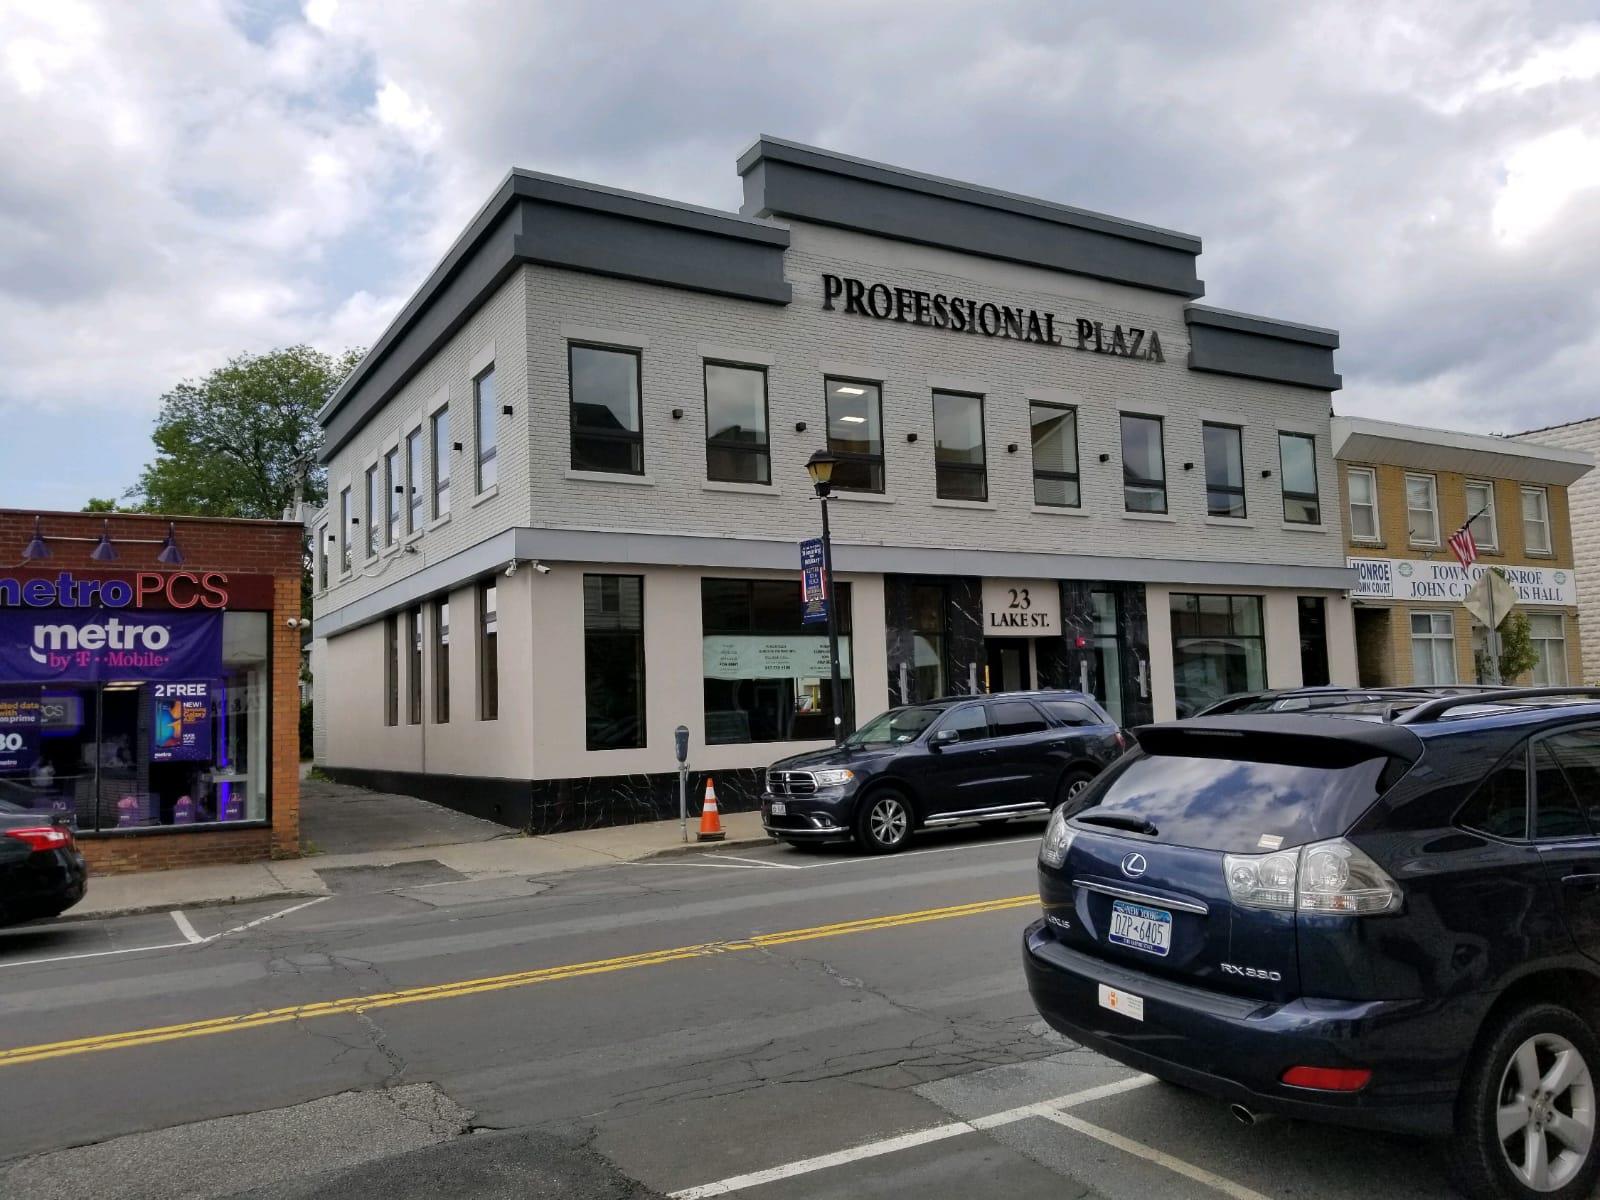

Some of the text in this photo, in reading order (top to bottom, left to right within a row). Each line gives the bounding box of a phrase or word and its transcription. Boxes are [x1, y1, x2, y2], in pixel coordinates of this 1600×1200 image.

[822, 274, 1165, 363] PROFESSIONAL PLAZA
[1431, 565, 1469, 581] TOWN
[1504, 569, 1542, 585] ONROE
[1356, 582, 1390, 593] OWN COURT
[1411, 581, 1445, 598] JOHN
[1449, 583, 1461, 597] C.
[1533, 587, 1563, 601] HALL
[1008, 588, 1031, 610] 23
[991, 612, 1049, 627] LAKE ST.
[34, 618, 170, 650] metro
[50, 653, 71, 669] by
[154, 683, 207, 697] 2 FREE
[10, 714, 35, 723] prime
[41, 705, 64, 717] CS
[1126, 905, 1156, 921] NEW YORK
